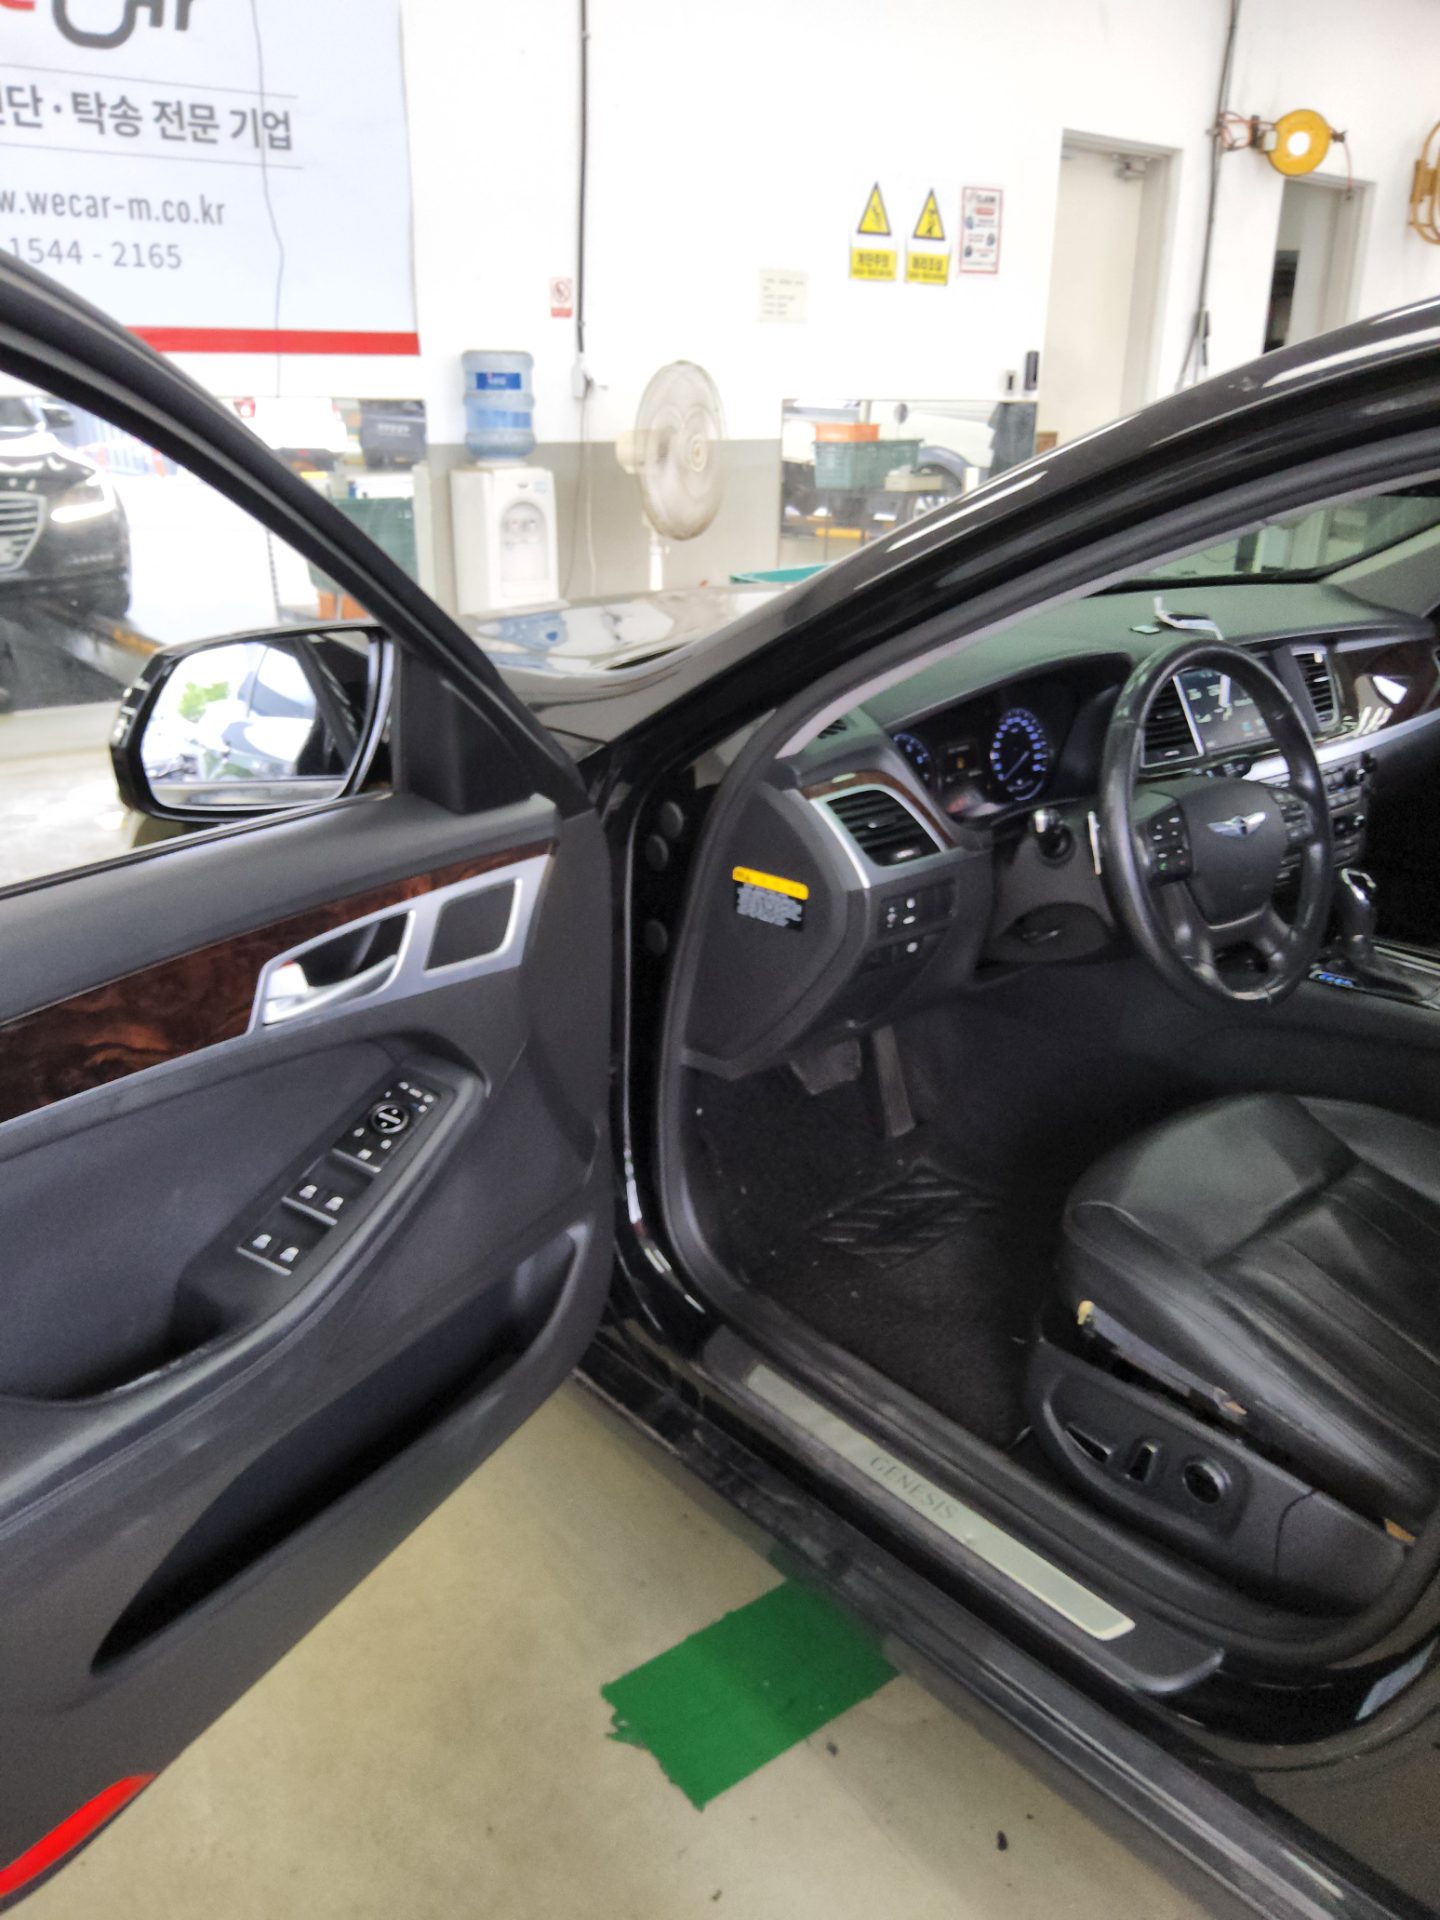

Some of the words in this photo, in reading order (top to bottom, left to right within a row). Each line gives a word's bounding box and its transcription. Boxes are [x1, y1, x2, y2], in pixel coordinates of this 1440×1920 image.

[152, 100, 220, 145] 전문
[229, 107, 292, 151] 기업
[9, 237, 83, 265] 1544
[111, 241, 183, 269] 2165
[869, 1455, 958, 1520] GENESIS
